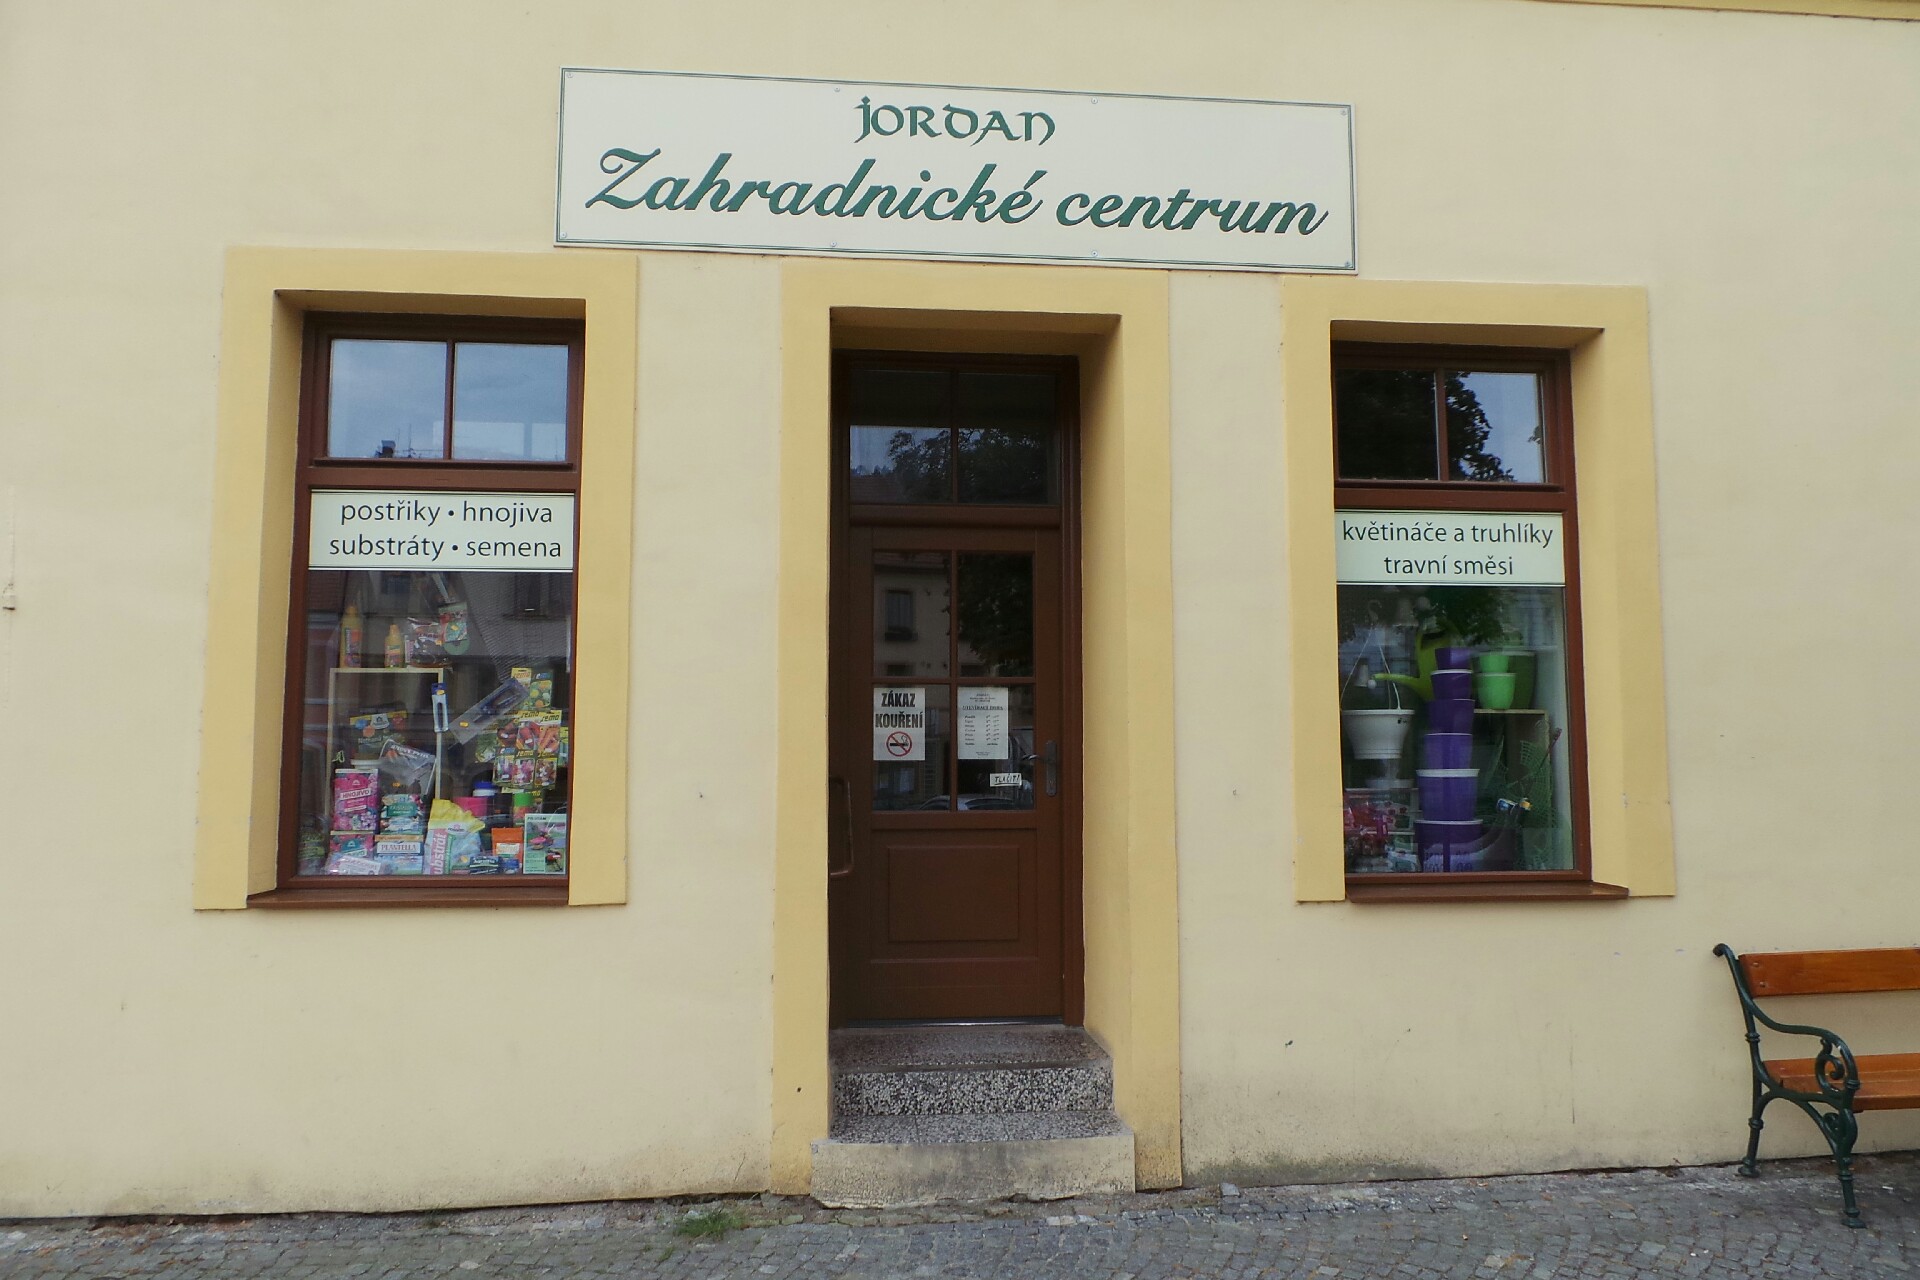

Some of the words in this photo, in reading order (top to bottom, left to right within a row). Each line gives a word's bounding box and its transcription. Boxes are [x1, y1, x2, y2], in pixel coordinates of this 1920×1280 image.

[585, 147, 1048, 224] Zahradnické
[1056, 188, 1330, 236] centrum
[341, 500, 441, 527] postřiky
[462, 500, 553, 528] hnojiva
[329, 533, 445, 562] substráty
[465, 540, 562, 558] semena
[1342, 519, 1447, 542] květináče
[1453, 527, 1465, 542] a
[1470, 522, 1553, 549] truhlíky
[1383, 555, 1448, 574] travní
[1453, 555, 1514, 576] směsi
[881, 690, 916, 708] ZÁKAZ
[875, 710, 923, 729] KOUŘENÍ
[430, 832, 448, 875] ubstrát
